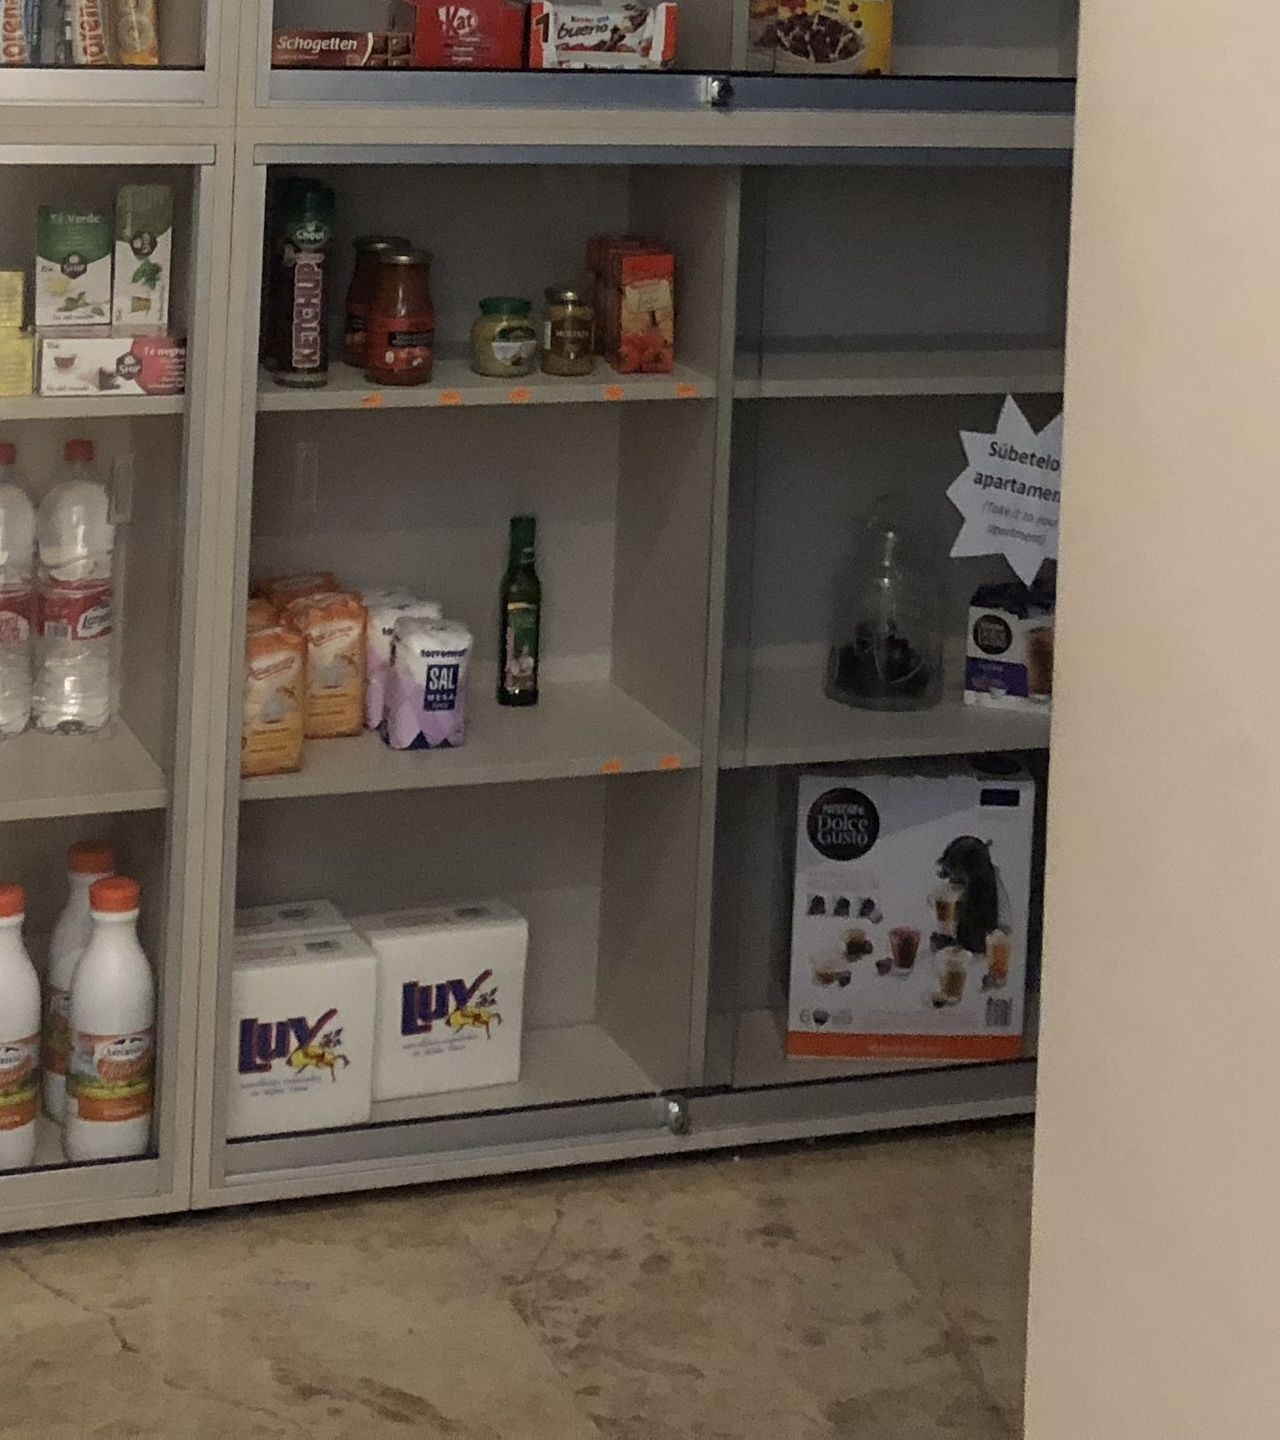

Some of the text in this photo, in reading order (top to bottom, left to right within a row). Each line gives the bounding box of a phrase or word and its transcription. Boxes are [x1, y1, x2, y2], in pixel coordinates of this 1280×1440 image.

[535, 12, 550, 43] 1
[556, 16, 610, 41] bueno
[276, 34, 358, 53] Schogetten
[292, 261, 321, 368] KETCHUP
[988, 440, 1061, 471] Súbetelo
[973, 470, 1061, 503] apartamen
[429, 669, 455, 690] SAL
[819, 814, 868, 832] Dolce
[817, 829, 869, 845] Gusto
